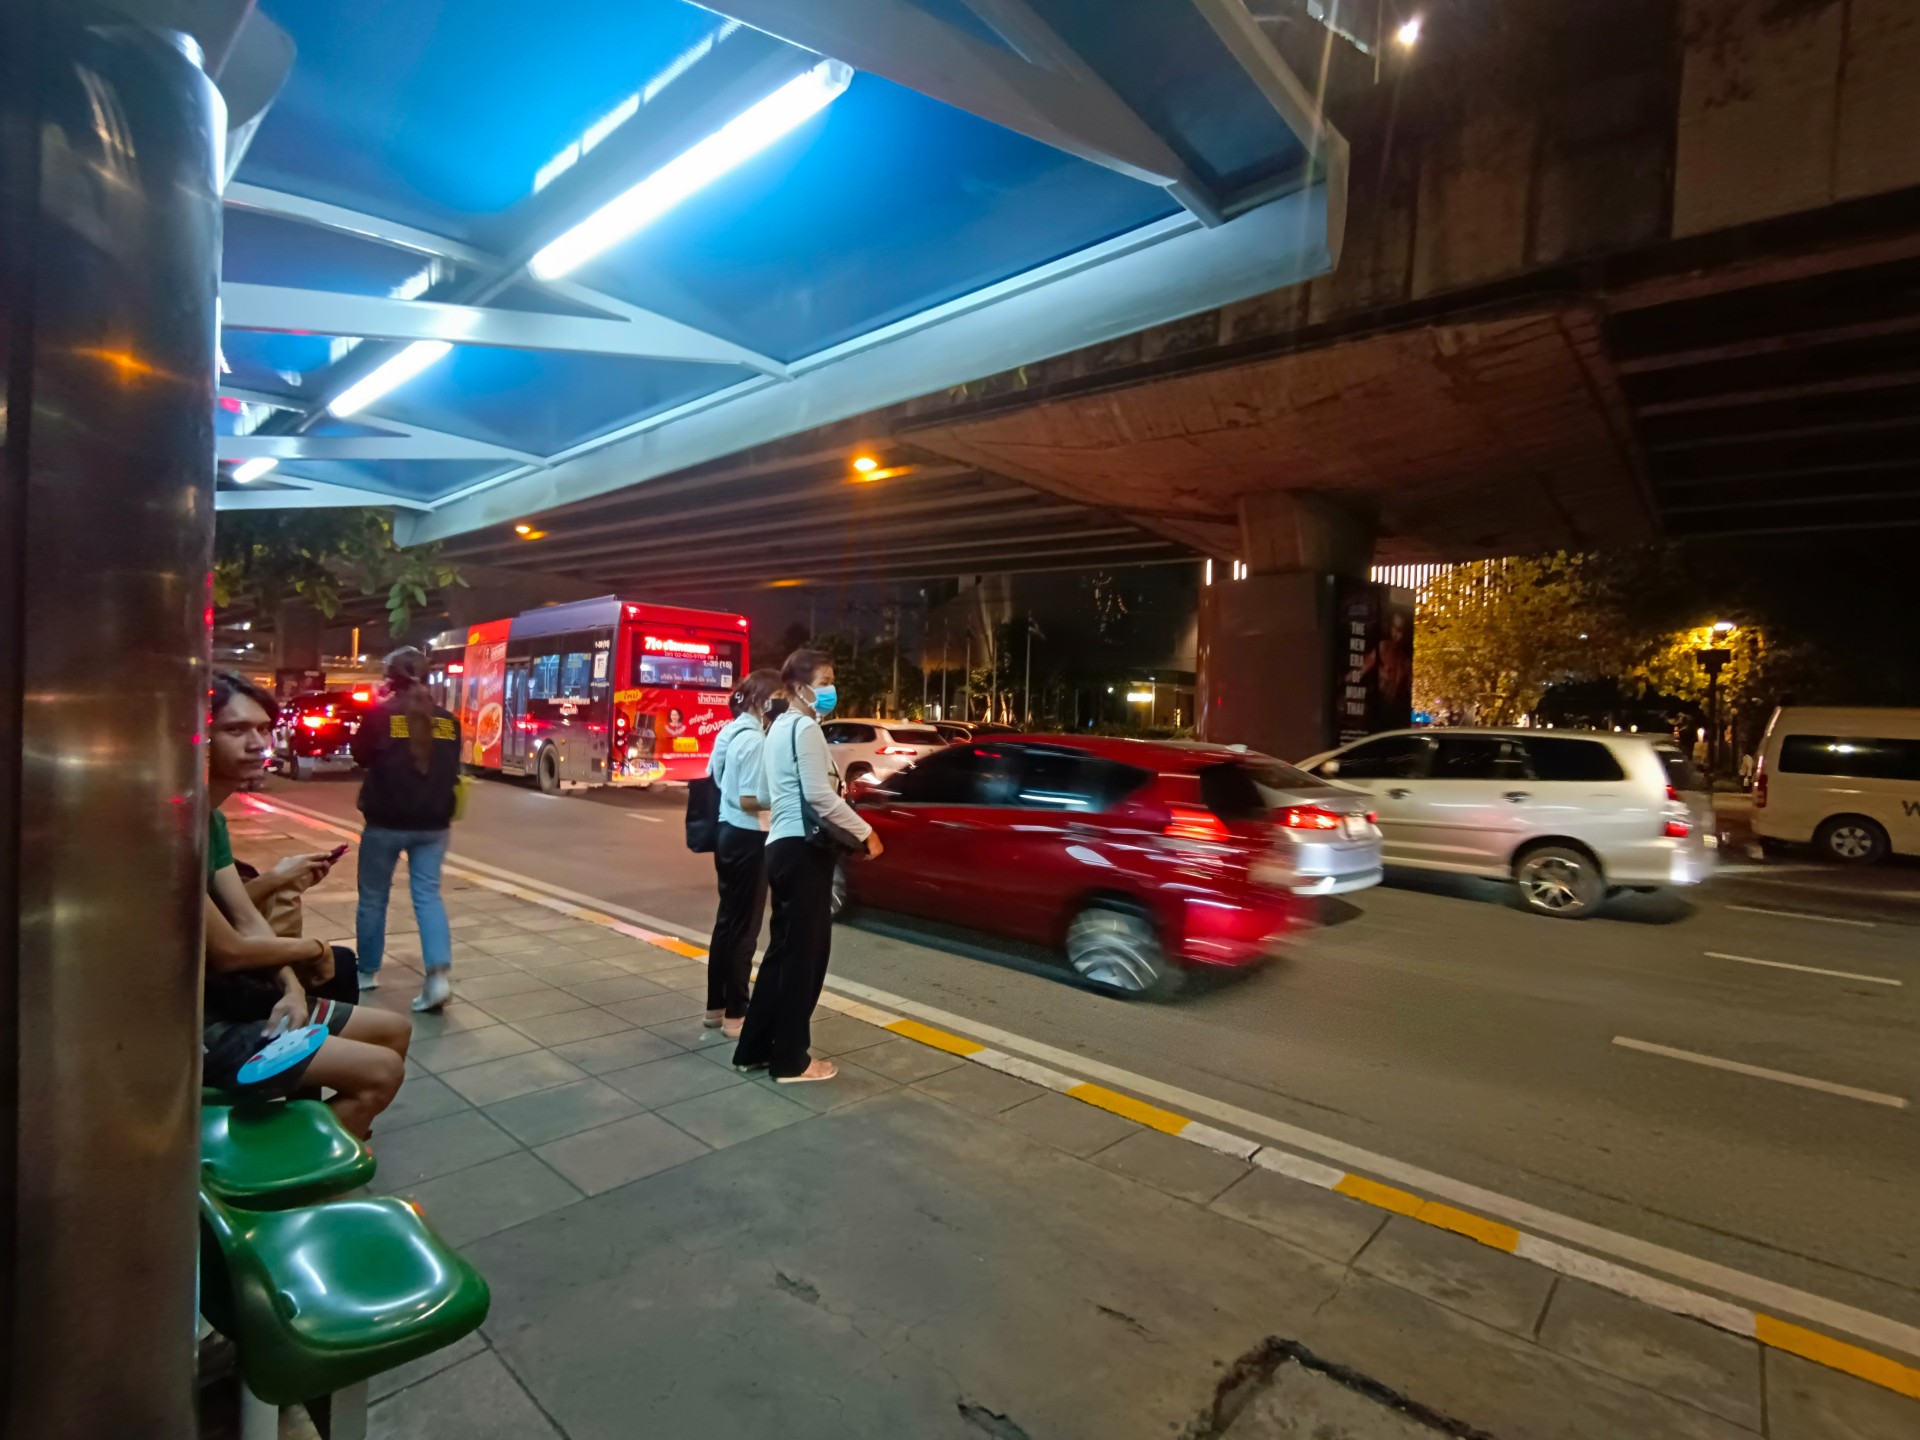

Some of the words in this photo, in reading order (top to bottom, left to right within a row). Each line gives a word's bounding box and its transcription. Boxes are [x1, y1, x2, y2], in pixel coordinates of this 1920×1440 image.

[1351, 622, 1366, 636] THE
[1350, 637, 1366, 652] NEW
[1350, 653, 1364, 667] ERA
[1352, 670, 1361, 683] OF
[1345, 686, 1367, 699] MUAY
[1346, 701, 1365, 716] THAI
